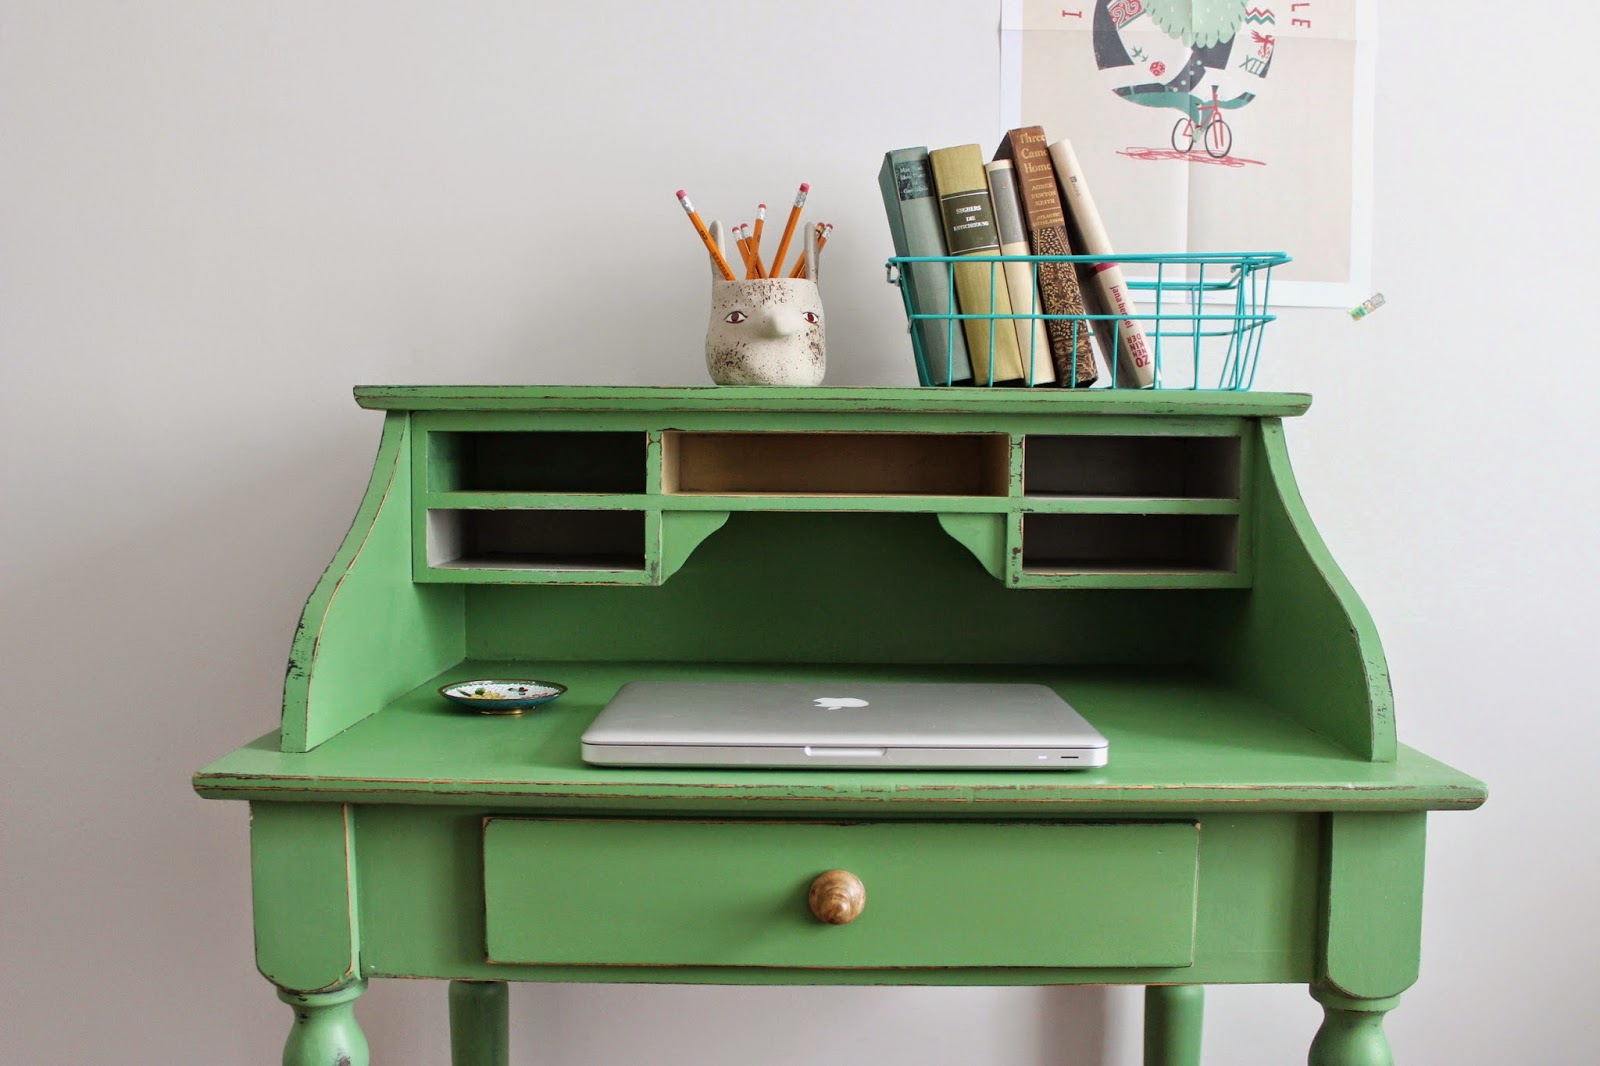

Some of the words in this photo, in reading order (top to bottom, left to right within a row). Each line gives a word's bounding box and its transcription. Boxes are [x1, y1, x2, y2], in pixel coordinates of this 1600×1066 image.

[1017, 132, 1046, 144] Three
[1021, 148, 1048, 159] Came
[1024, 162, 1052, 174] Home
[1032, 183, 1053, 191] AGNES
[1110, 284, 1122, 303] jana
